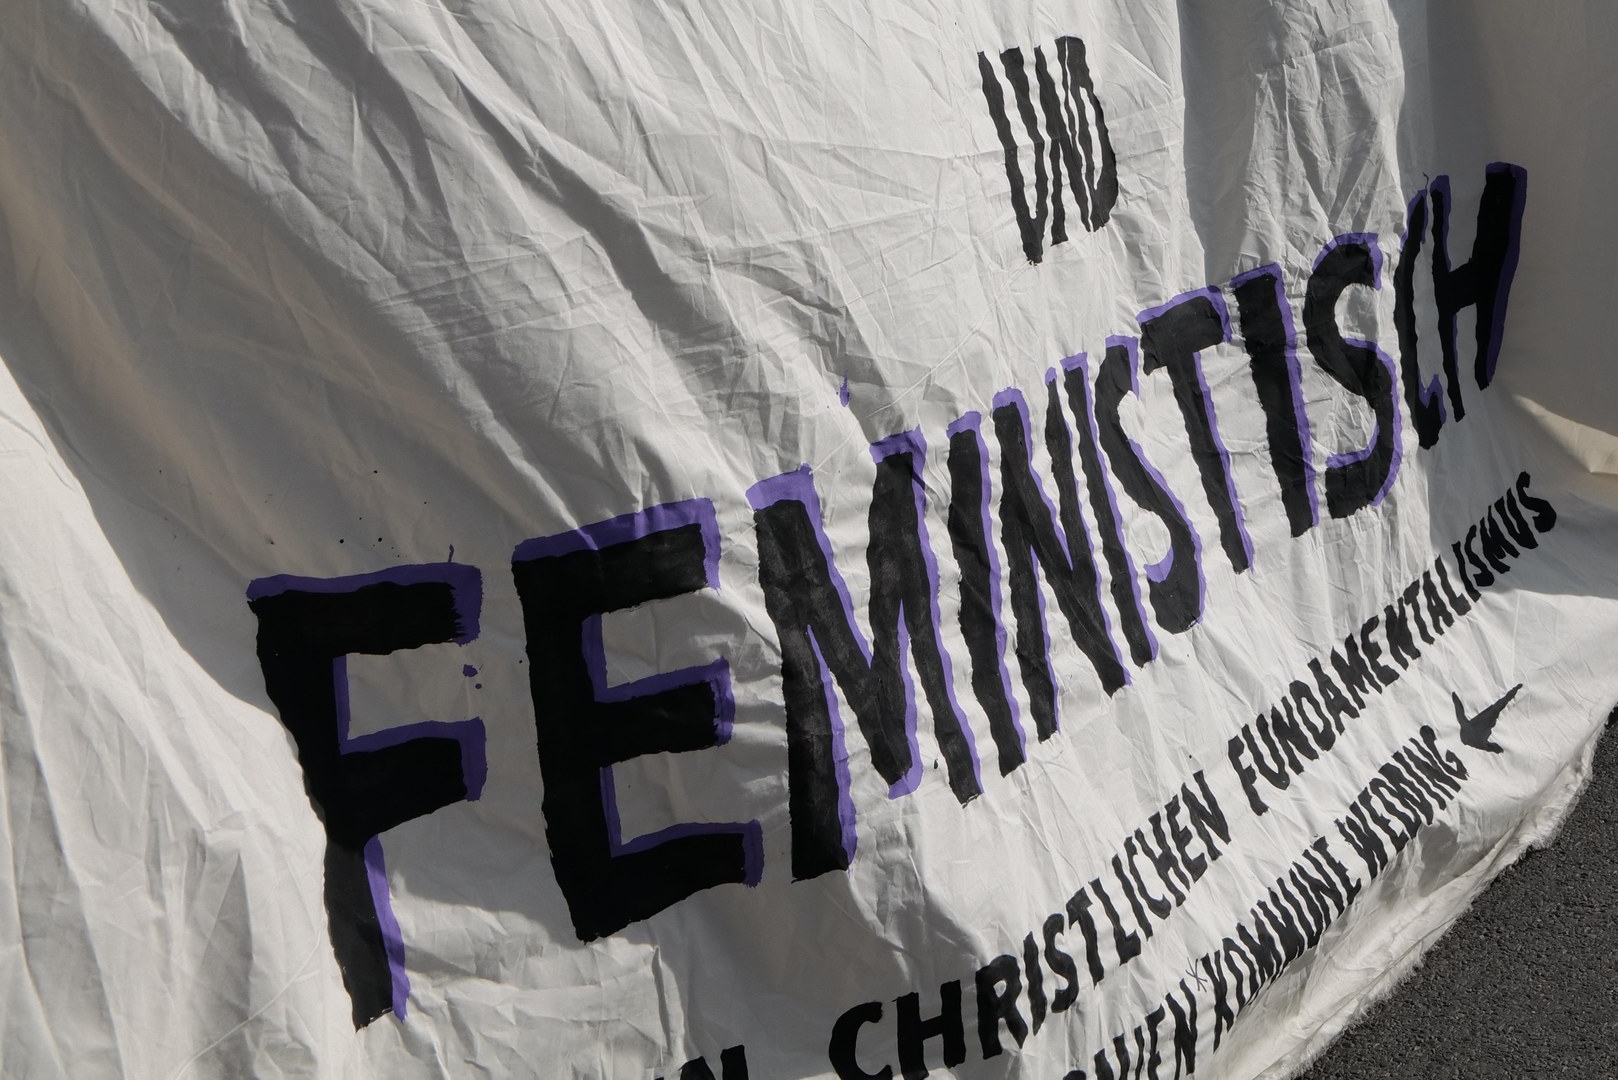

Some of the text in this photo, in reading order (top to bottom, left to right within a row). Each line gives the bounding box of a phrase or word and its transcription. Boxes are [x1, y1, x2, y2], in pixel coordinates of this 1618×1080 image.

[977, 35, 1119, 266] UND
[247, 162, 1528, 1031] FEMINISTISCH
[829, 471, 1557, 1080] CHRISTLICHEN FUNDAMENTALISMUS
[1333, 724, 1470, 881] WEDDING
